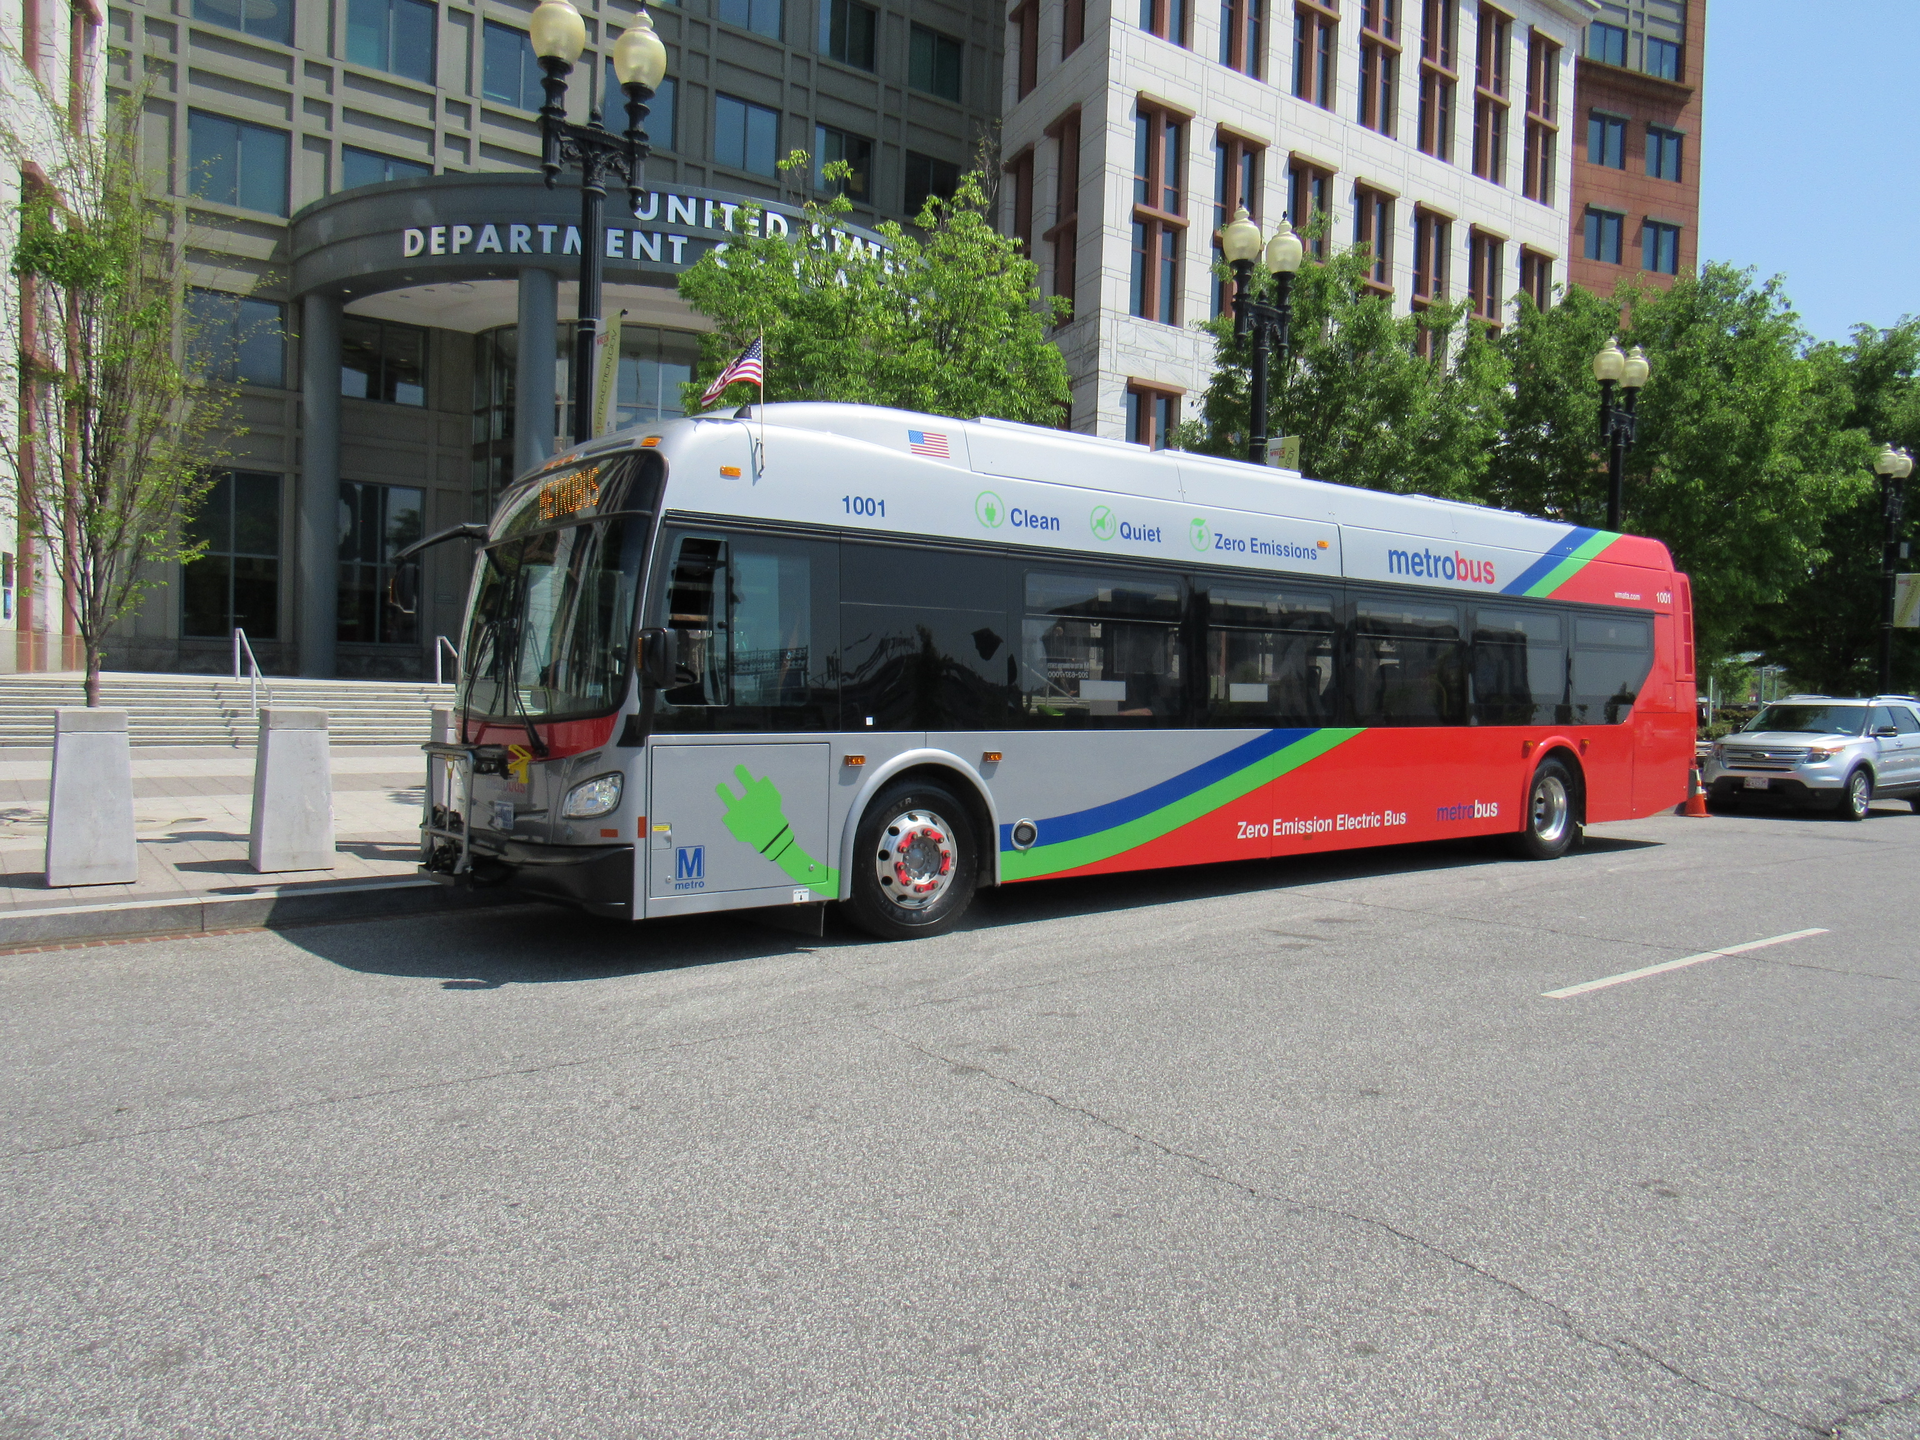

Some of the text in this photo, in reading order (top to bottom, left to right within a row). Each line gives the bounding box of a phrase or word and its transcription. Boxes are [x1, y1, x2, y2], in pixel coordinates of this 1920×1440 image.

[633, 192, 789, 240] UNITED
[540, 467, 599, 521] METROBUS
[842, 495, 885, 517] 1001
[1010, 508, 1060, 531] Clean
[1120, 522, 1162, 542] Quiet
[1214, 533, 1317, 560] Zero Emissions
[1388, 548, 1495, 584] metrobus
[1656, 592, 1671, 604] 1001
[1436, 799, 1498, 821] metrobus
[1237, 810, 1407, 839] Zero Emission Electric Bus
[678, 848, 703, 878] M
[675, 881, 705, 890] metro
